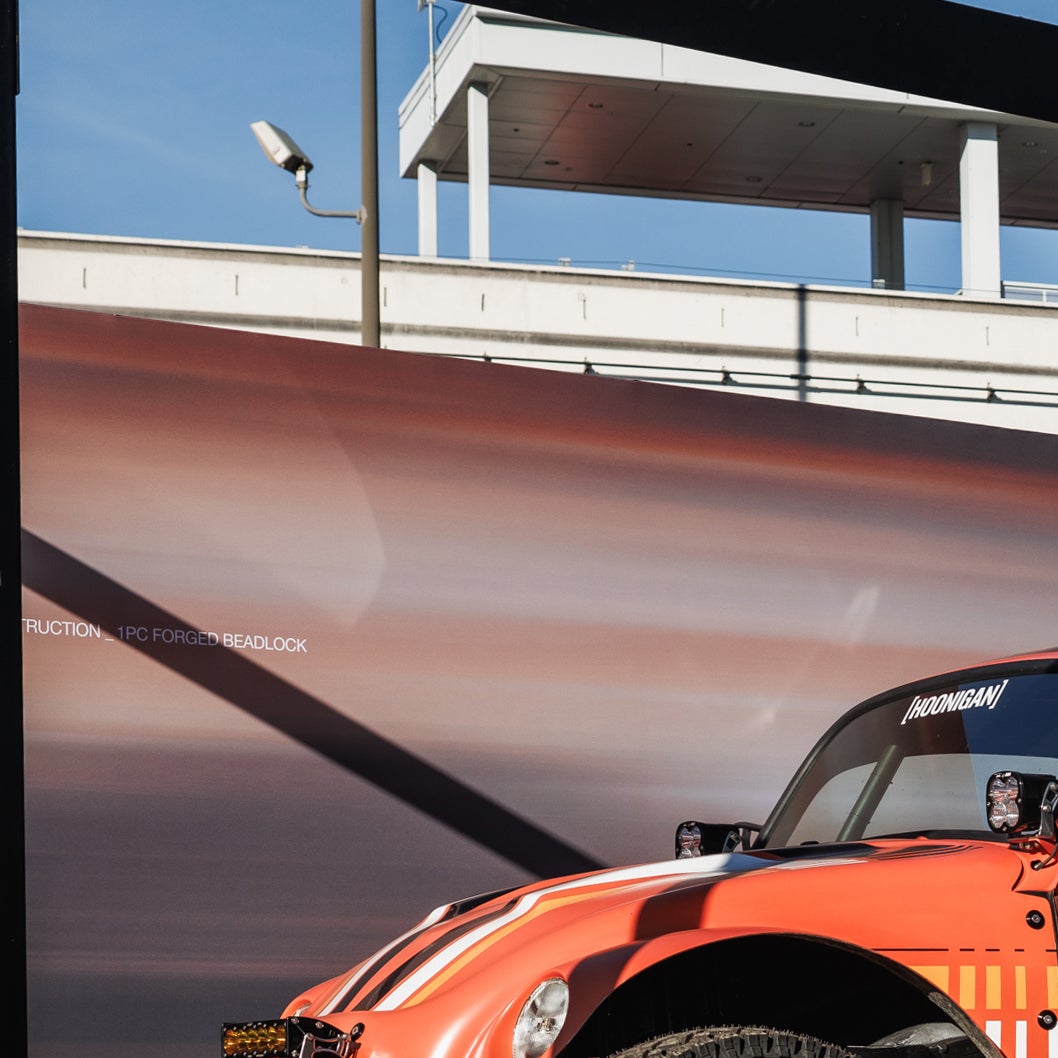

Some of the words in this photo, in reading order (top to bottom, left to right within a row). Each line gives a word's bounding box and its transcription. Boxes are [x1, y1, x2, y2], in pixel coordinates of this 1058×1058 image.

[21, 617, 101, 638] RUCTION
[117, 625, 149, 642] 1PC
[153, 627, 219, 647] FORGED
[223, 632, 308, 653] BEADLOCK
[901, 679, 1009, 725] [HOONIGAN]
